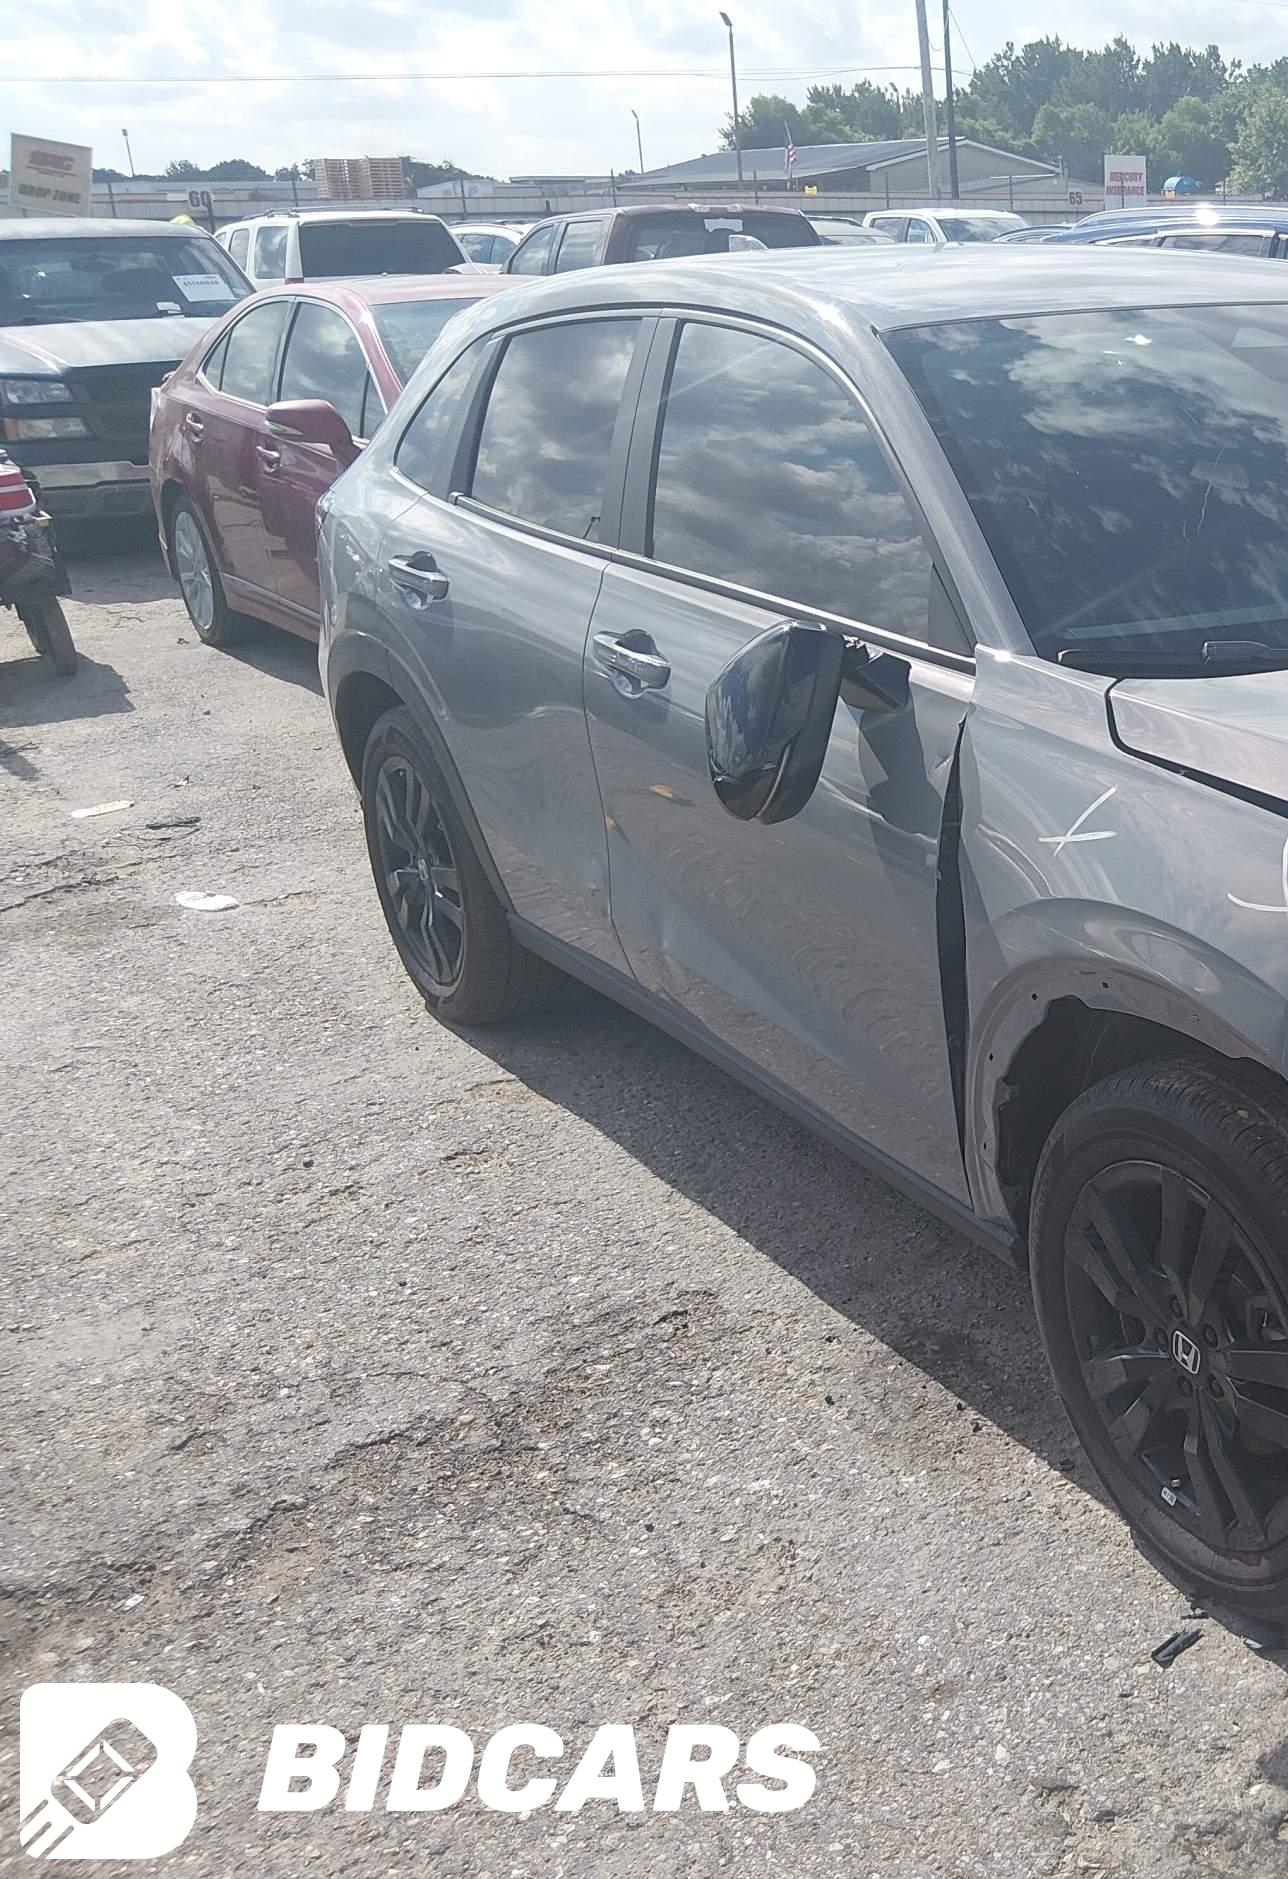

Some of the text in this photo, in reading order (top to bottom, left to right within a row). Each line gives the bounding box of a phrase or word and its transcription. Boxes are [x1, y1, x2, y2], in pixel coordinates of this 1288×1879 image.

[1109, 172, 1144, 182] MERCURY
[18, 184, 82, 205] DROP ZONE
[1106, 186, 1145, 197] INSURANCE
[1069, 191, 1083, 205] 65
